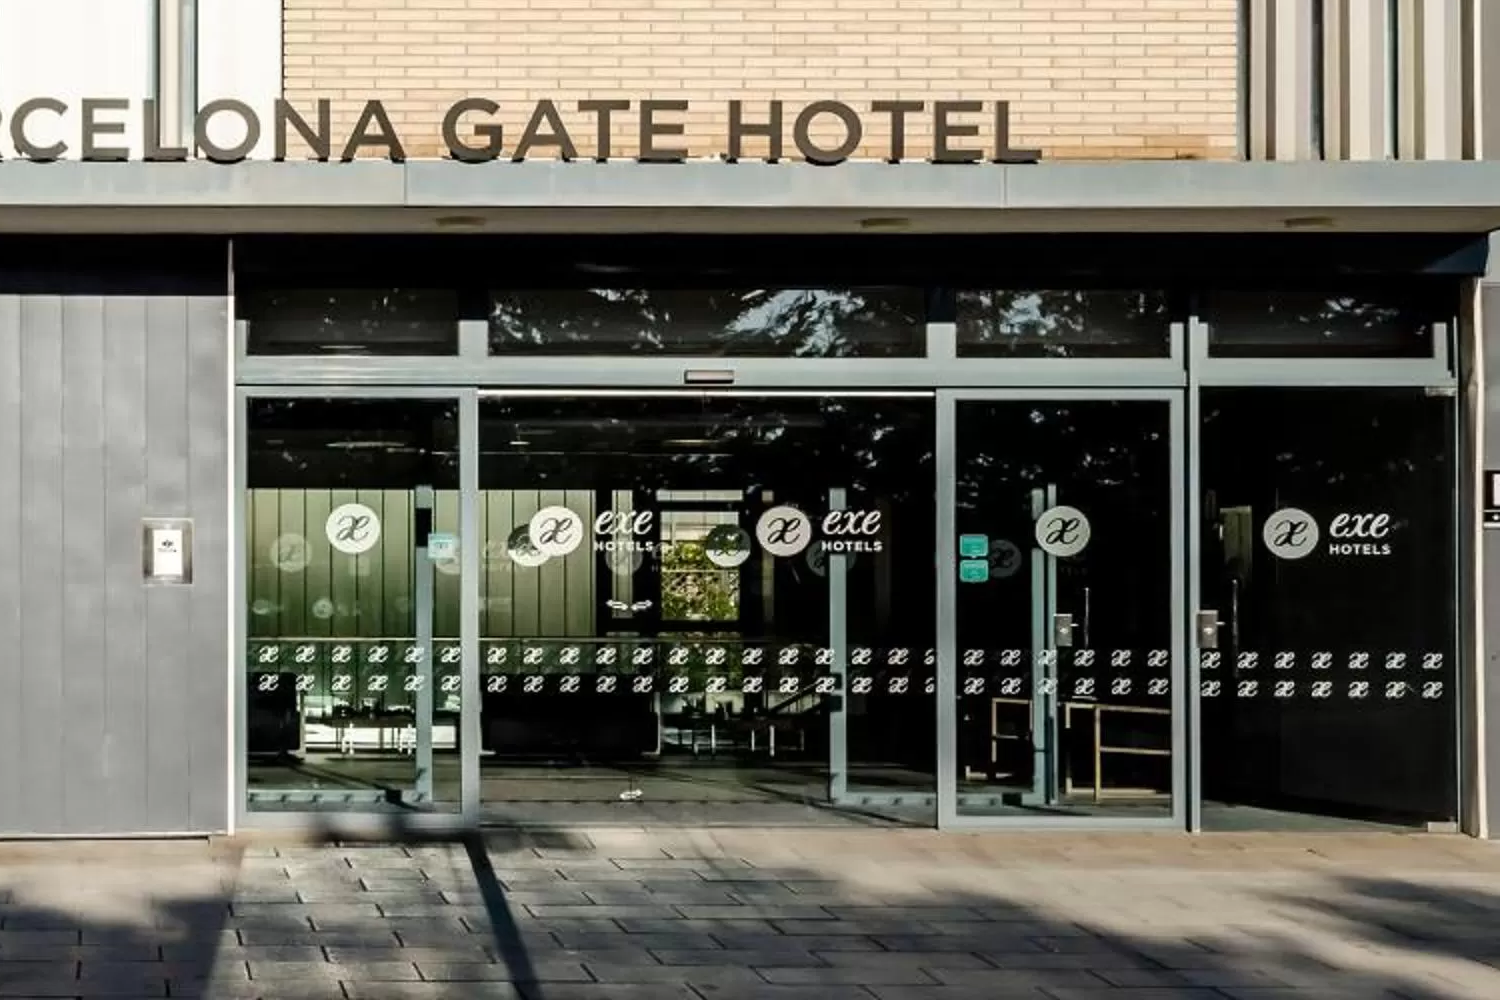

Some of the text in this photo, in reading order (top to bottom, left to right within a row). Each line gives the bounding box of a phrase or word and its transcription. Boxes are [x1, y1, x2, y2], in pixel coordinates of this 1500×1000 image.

[442, 98, 688, 163] GATE
[729, 99, 1041, 166] HOTEL
[595, 510, 653, 535] exe
[821, 509, 881, 535] exe
[1329, 512, 1390, 538] exe
[594, 541, 654, 552] HOTELS
[821, 541, 882, 552] HOTELS
[1329, 544, 1391, 555] HOTELS
